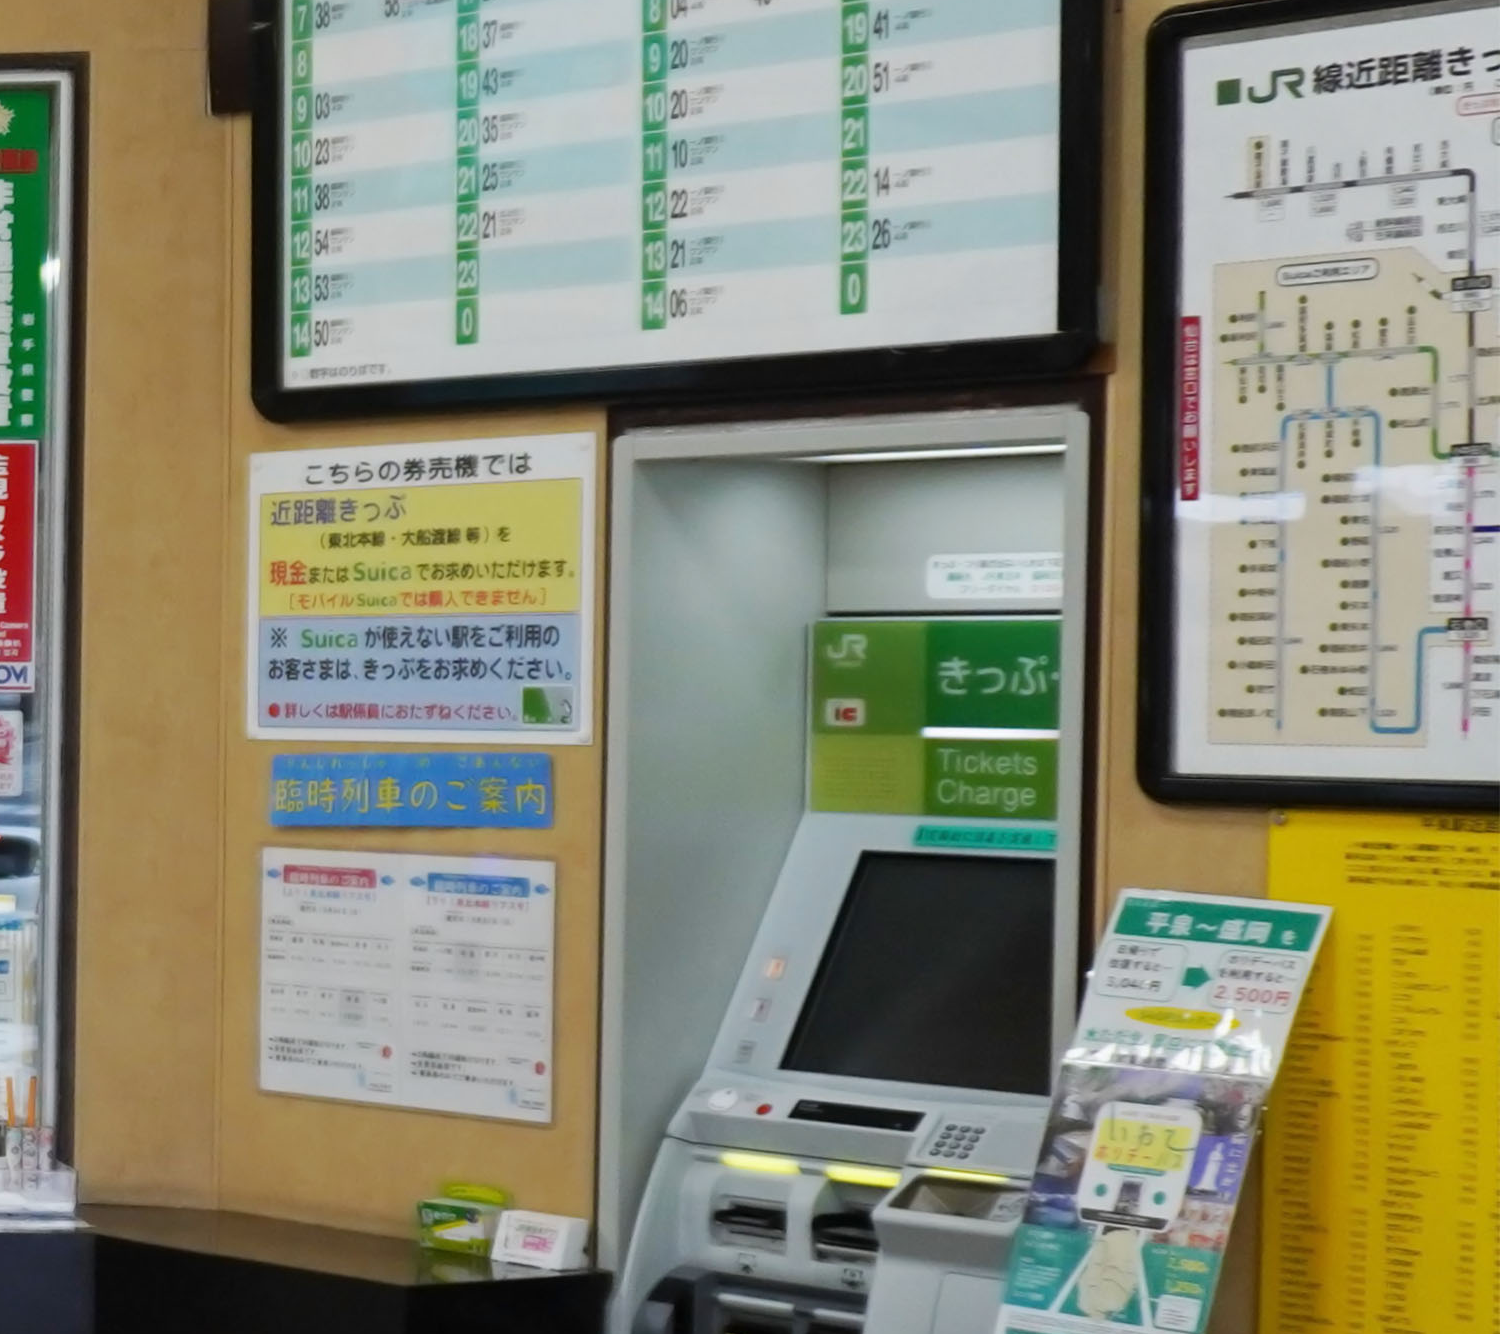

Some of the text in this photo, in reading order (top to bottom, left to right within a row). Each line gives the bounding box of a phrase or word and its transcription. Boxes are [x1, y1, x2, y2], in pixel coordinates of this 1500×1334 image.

[482, 20, 499, 48] 37
[305, 452, 532, 486] こちらの券売機では
[270, 493, 408, 526] 近距離きっぷ
[301, 629, 358, 649] Suica
[827, 633, 868, 660] JR
[268, 657, 573, 681] お客さまは、きっぷをお求めください。
[284, 703, 519, 720] 詳しくは駅係員におたずねください。
[936, 747, 1037, 777] Tickets
[274, 777, 547, 815] 臨時列車のご案内
[936, 780, 1037, 811] Charge
